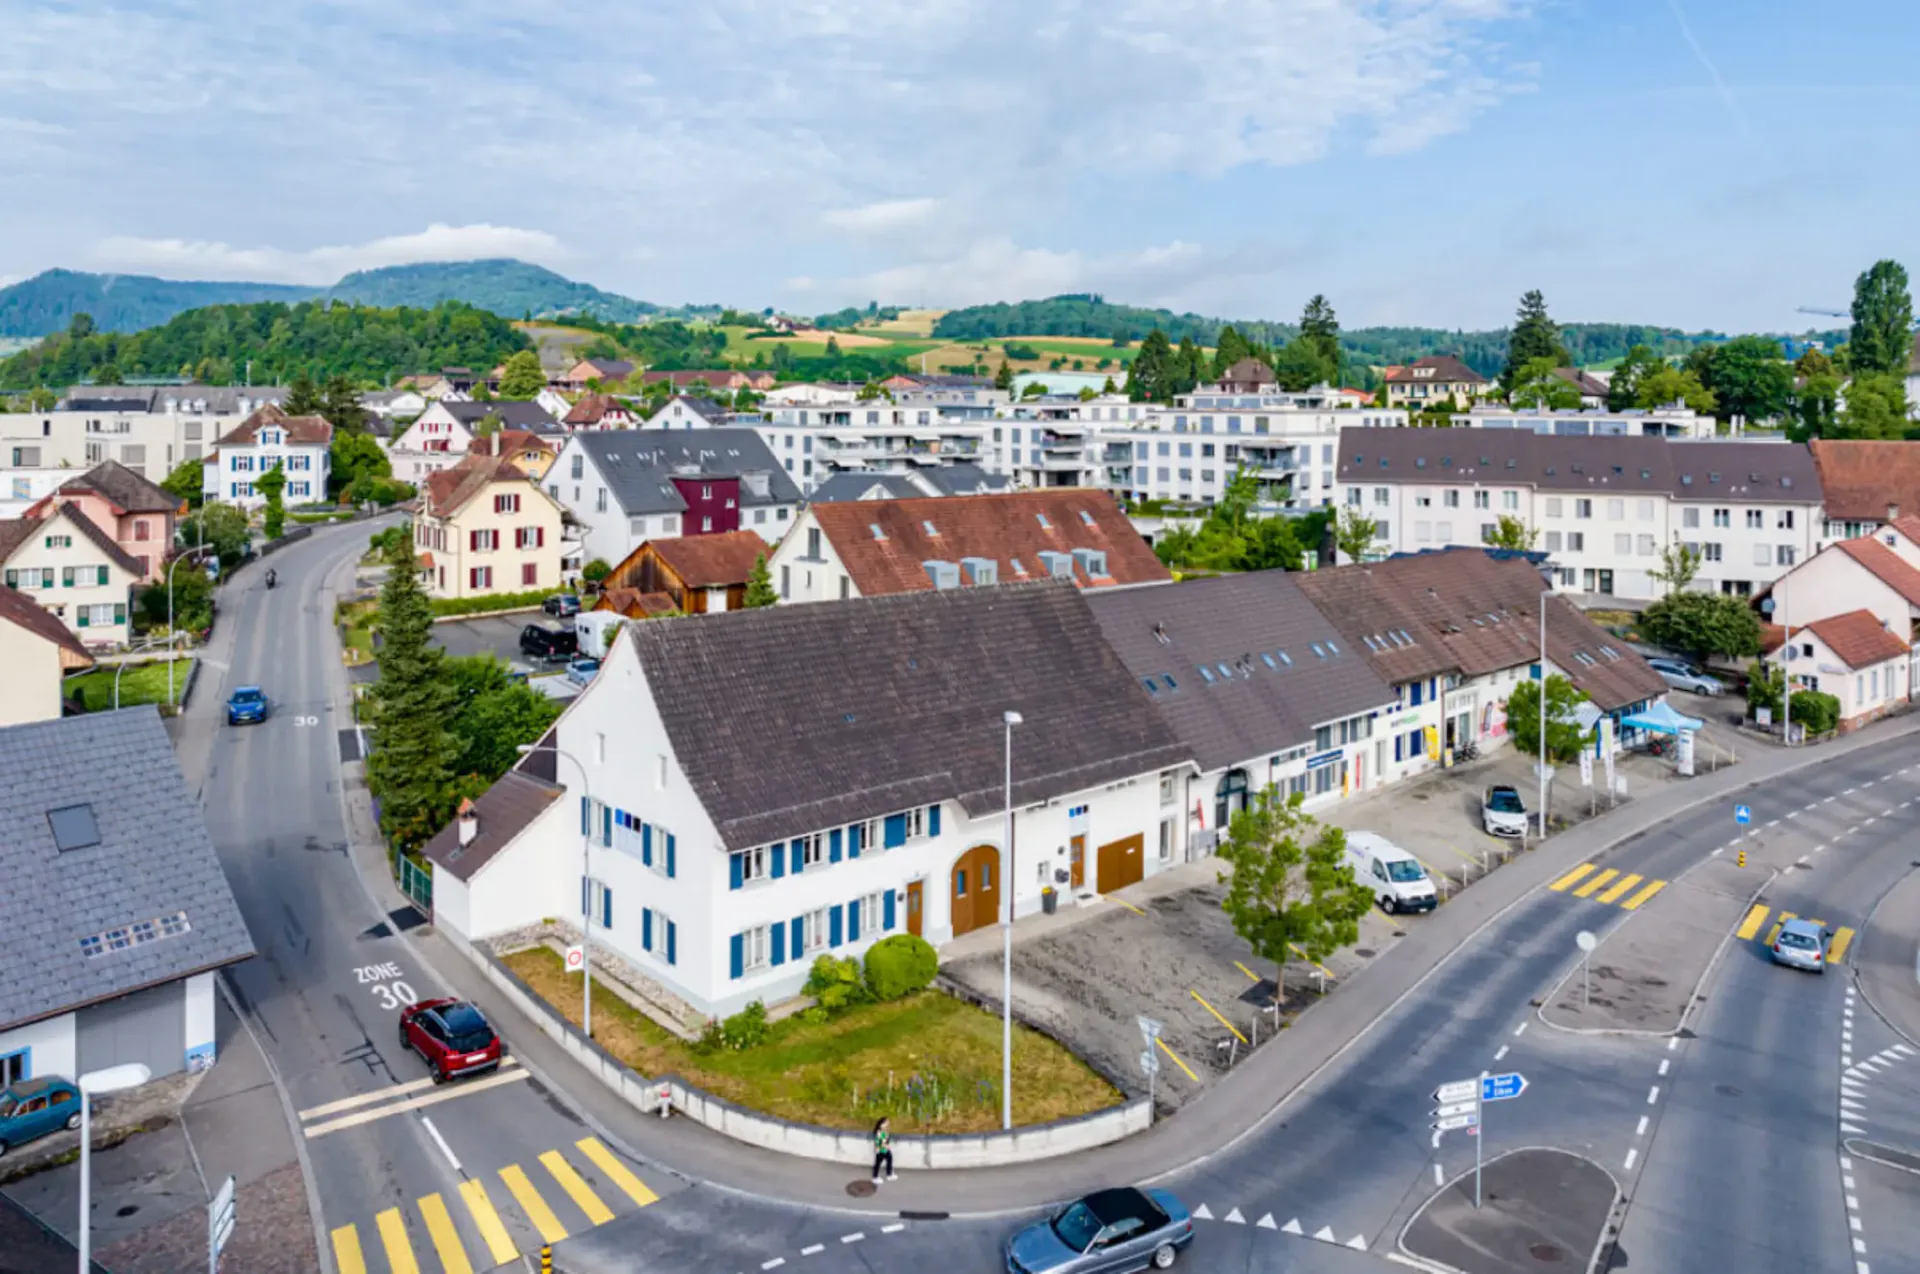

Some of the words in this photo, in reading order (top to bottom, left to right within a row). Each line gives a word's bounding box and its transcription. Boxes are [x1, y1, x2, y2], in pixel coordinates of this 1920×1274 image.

[294, 716, 318, 727] 30
[353, 961, 403, 983] ZONE
[371, 981, 418, 1010] 30
